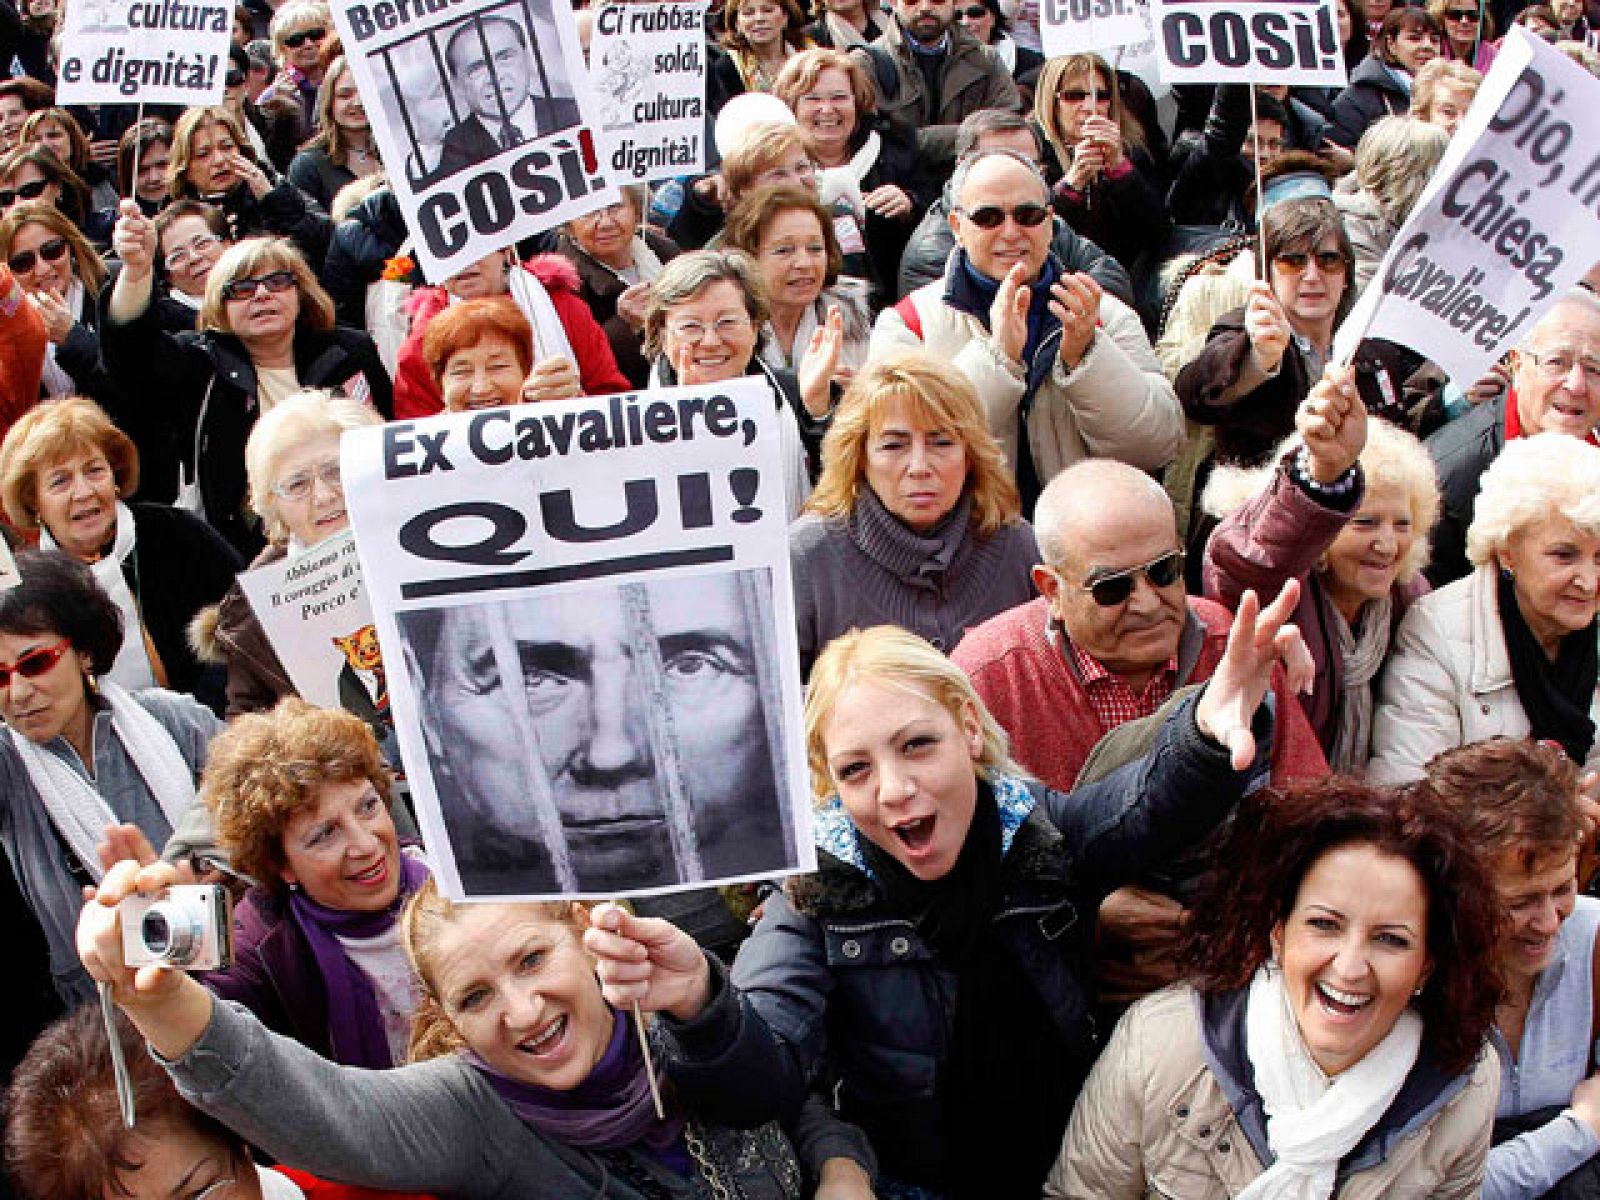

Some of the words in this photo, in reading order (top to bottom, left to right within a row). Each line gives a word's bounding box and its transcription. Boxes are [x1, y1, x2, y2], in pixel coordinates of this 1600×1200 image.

[127, 0, 228, 32] cultura
[598, 6, 626, 35] Ci
[630, 4, 701, 33] rubba:
[62, 57, 82, 83] e
[92, 47, 219, 96] dignità!
[654, 42, 703, 77] soldi,
[634, 92, 703, 123] cultura
[1487, 66, 1573, 188] Dio,
[612, 135, 698, 178] dignità!
[1441, 159, 1563, 300] Chiesa,
[1382, 232, 1531, 352] Cavaliere!
[384, 422, 455, 480] Ex
[467, 394, 758, 466] Cavaliere,
[399, 466, 764, 566] QUI!
